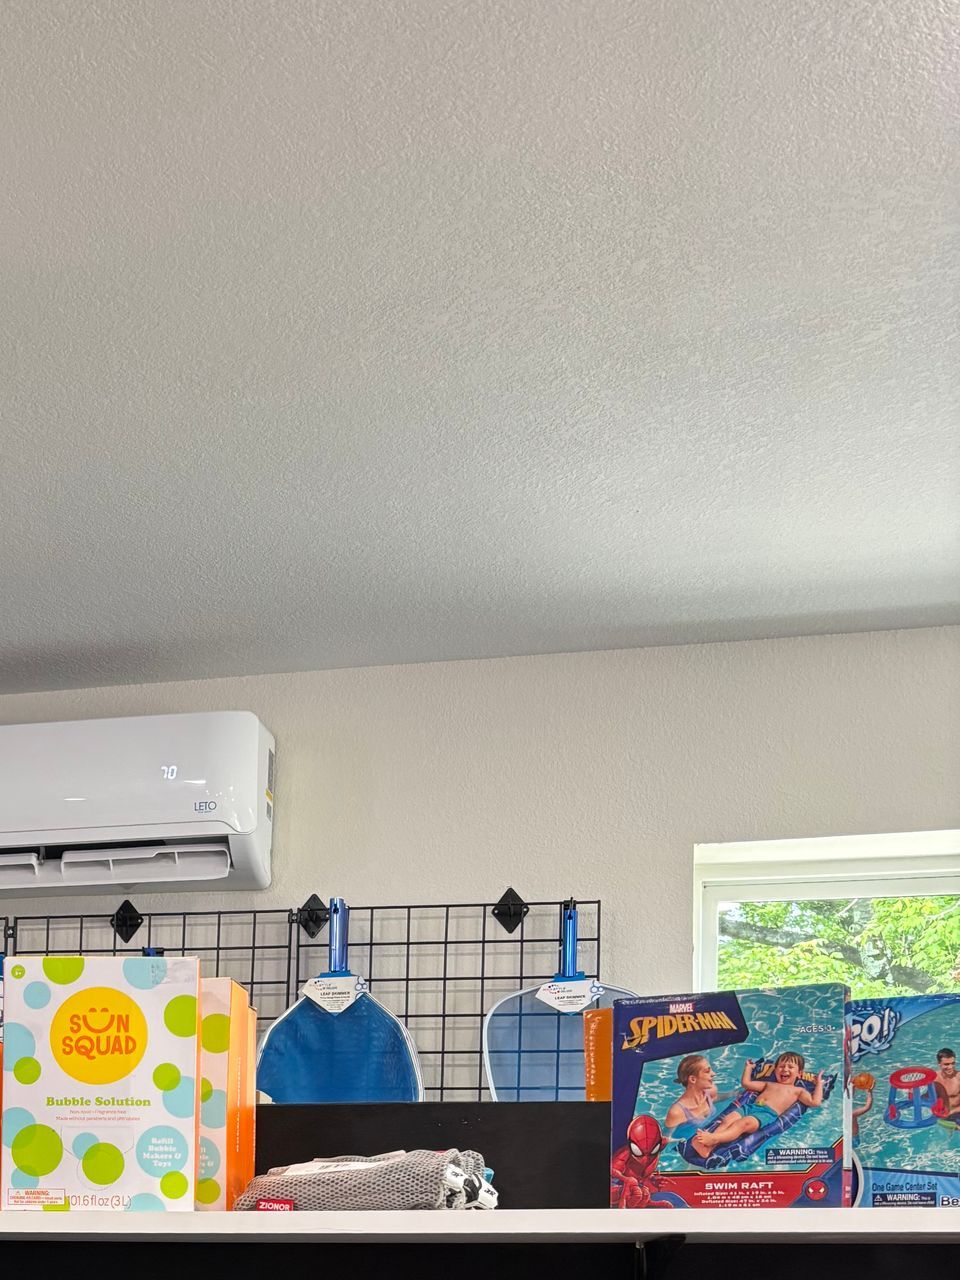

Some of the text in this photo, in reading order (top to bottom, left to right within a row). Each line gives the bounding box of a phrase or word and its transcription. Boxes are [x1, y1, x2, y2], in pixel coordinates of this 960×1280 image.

[161, 766, 177, 779] 70
[194, 801, 217, 811] LETO
[669, 1003, 693, 1013] MARVEL
[70, 1010, 130, 1034] SUN
[621, 1011, 738, 1050] SPIDER-MAN
[62, 1036, 136, 1060] SQUAD
[46, 1097, 151, 1107] Bubble Solution
[872, 1182, 937, 1191] One Game Center Set
[259, 1202, 290, 1211] ZIONOR
